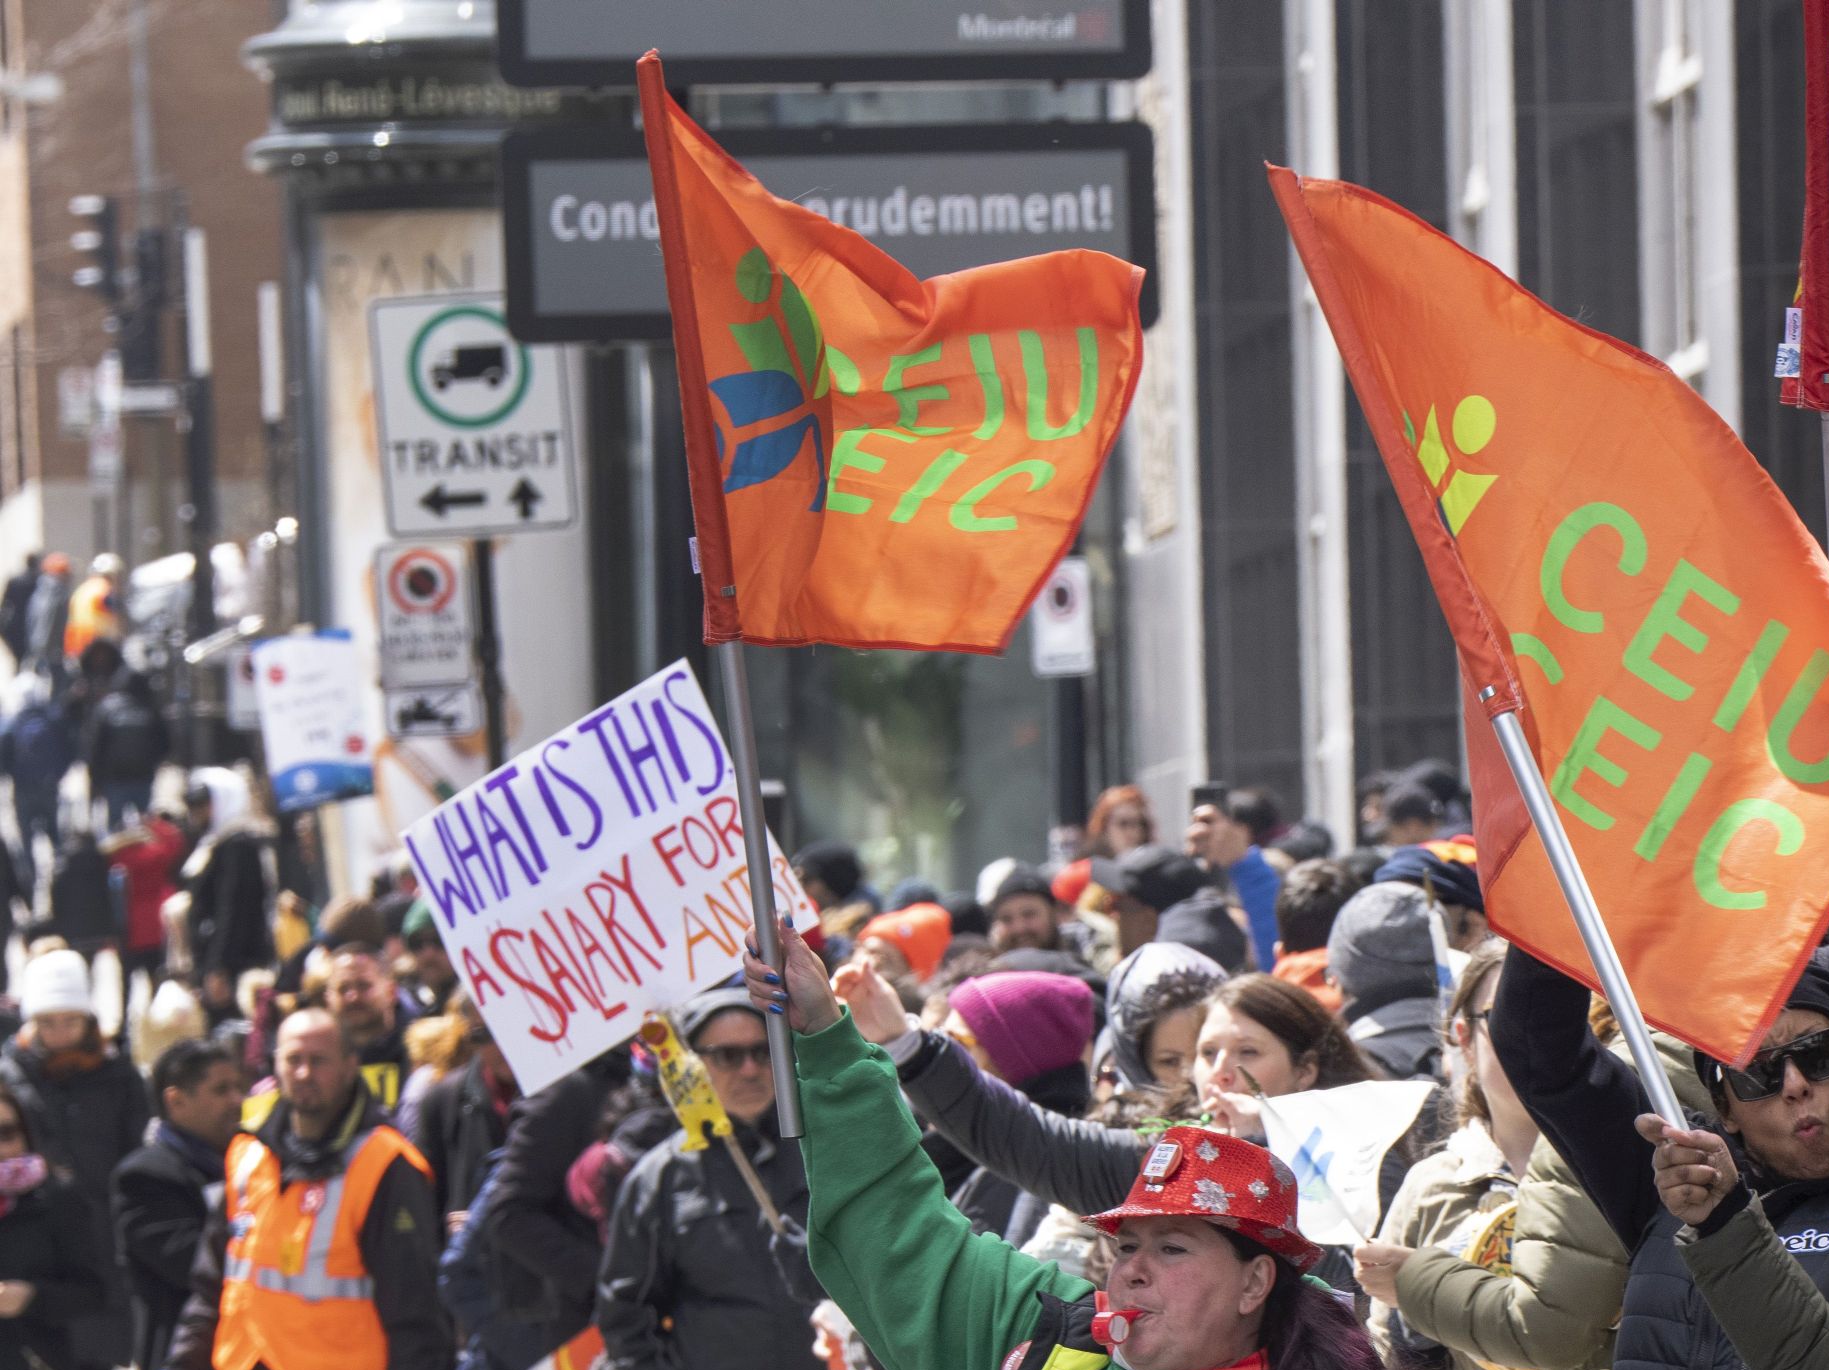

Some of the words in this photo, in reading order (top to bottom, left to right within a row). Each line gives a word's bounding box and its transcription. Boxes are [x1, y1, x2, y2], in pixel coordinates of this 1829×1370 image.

[387, 430, 561, 474] TRANSIT
[404, 763, 549, 931] WHAT
[532, 739, 604, 851] IS
[461, 946, 505, 1007] A
[651, 795, 744, 887] FOR
[683, 856, 807, 982] ANT?
